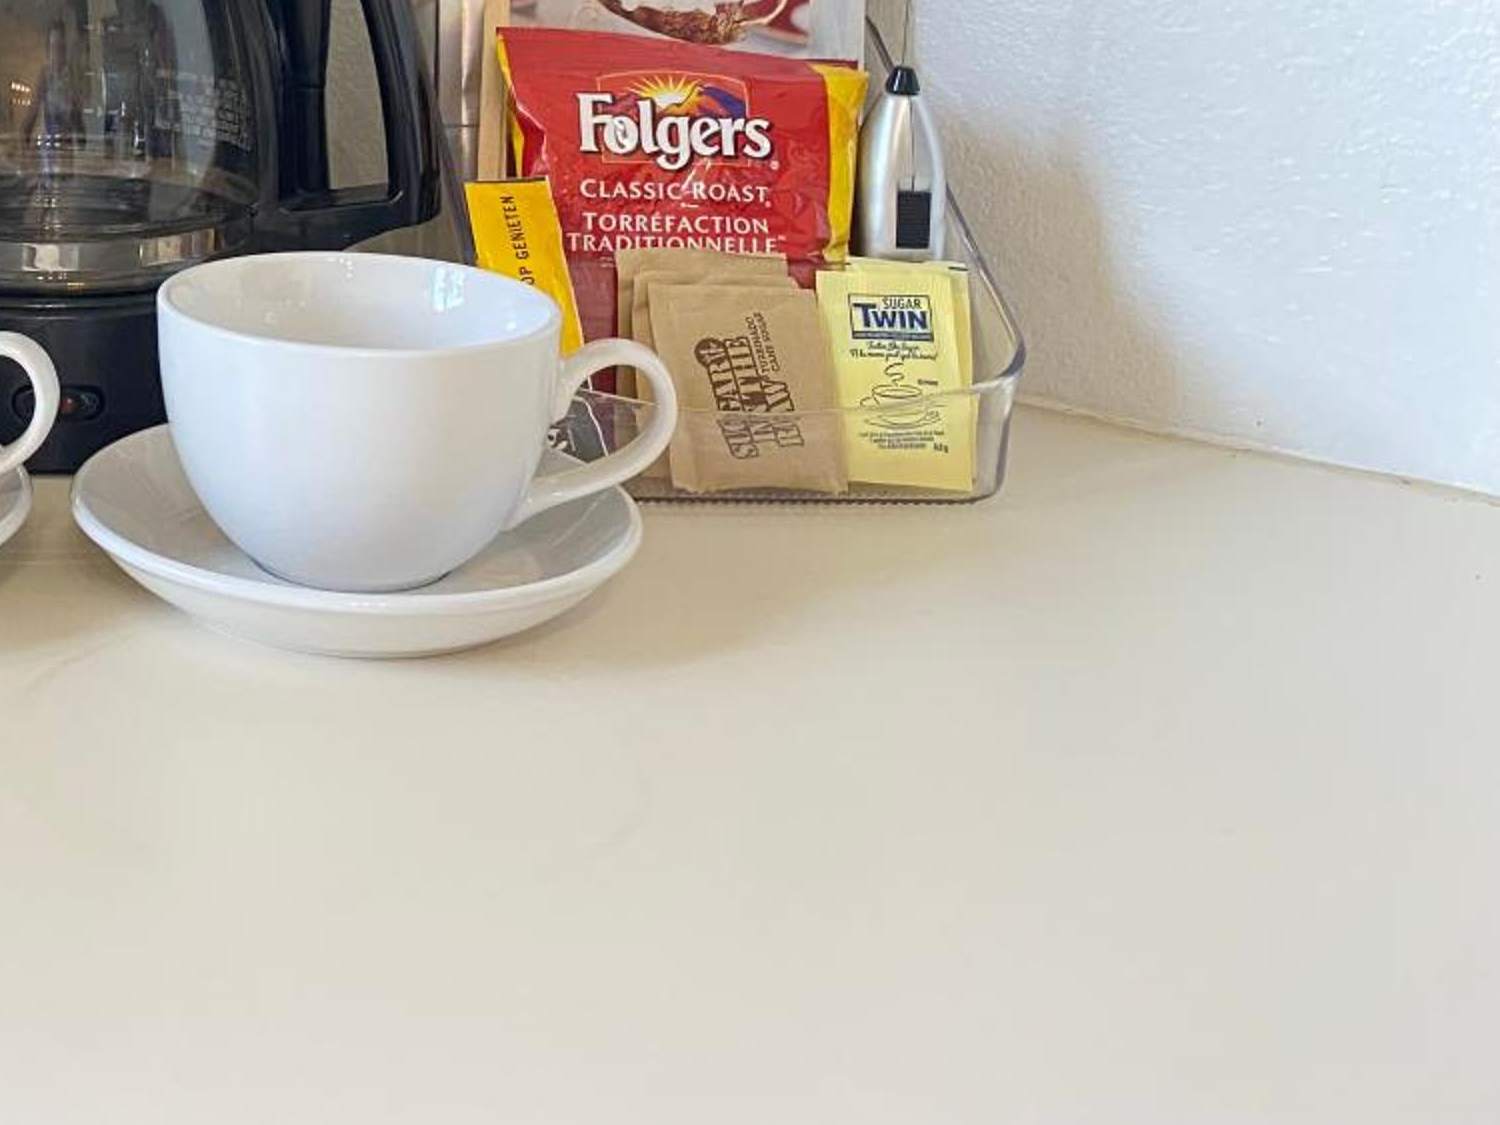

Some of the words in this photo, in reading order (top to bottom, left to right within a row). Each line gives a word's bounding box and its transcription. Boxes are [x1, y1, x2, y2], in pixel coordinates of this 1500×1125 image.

[576, 92, 773, 170] Folgers
[580, 178, 683, 200] CLASSIC
[691, 183, 769, 202] ROAST
[499, 195, 530, 260] GENIETEN
[582, 211, 769, 233] TORRÉFACTION
[852, 302, 928, 329] TWIN
[882, 297, 922, 310] SUGAR
